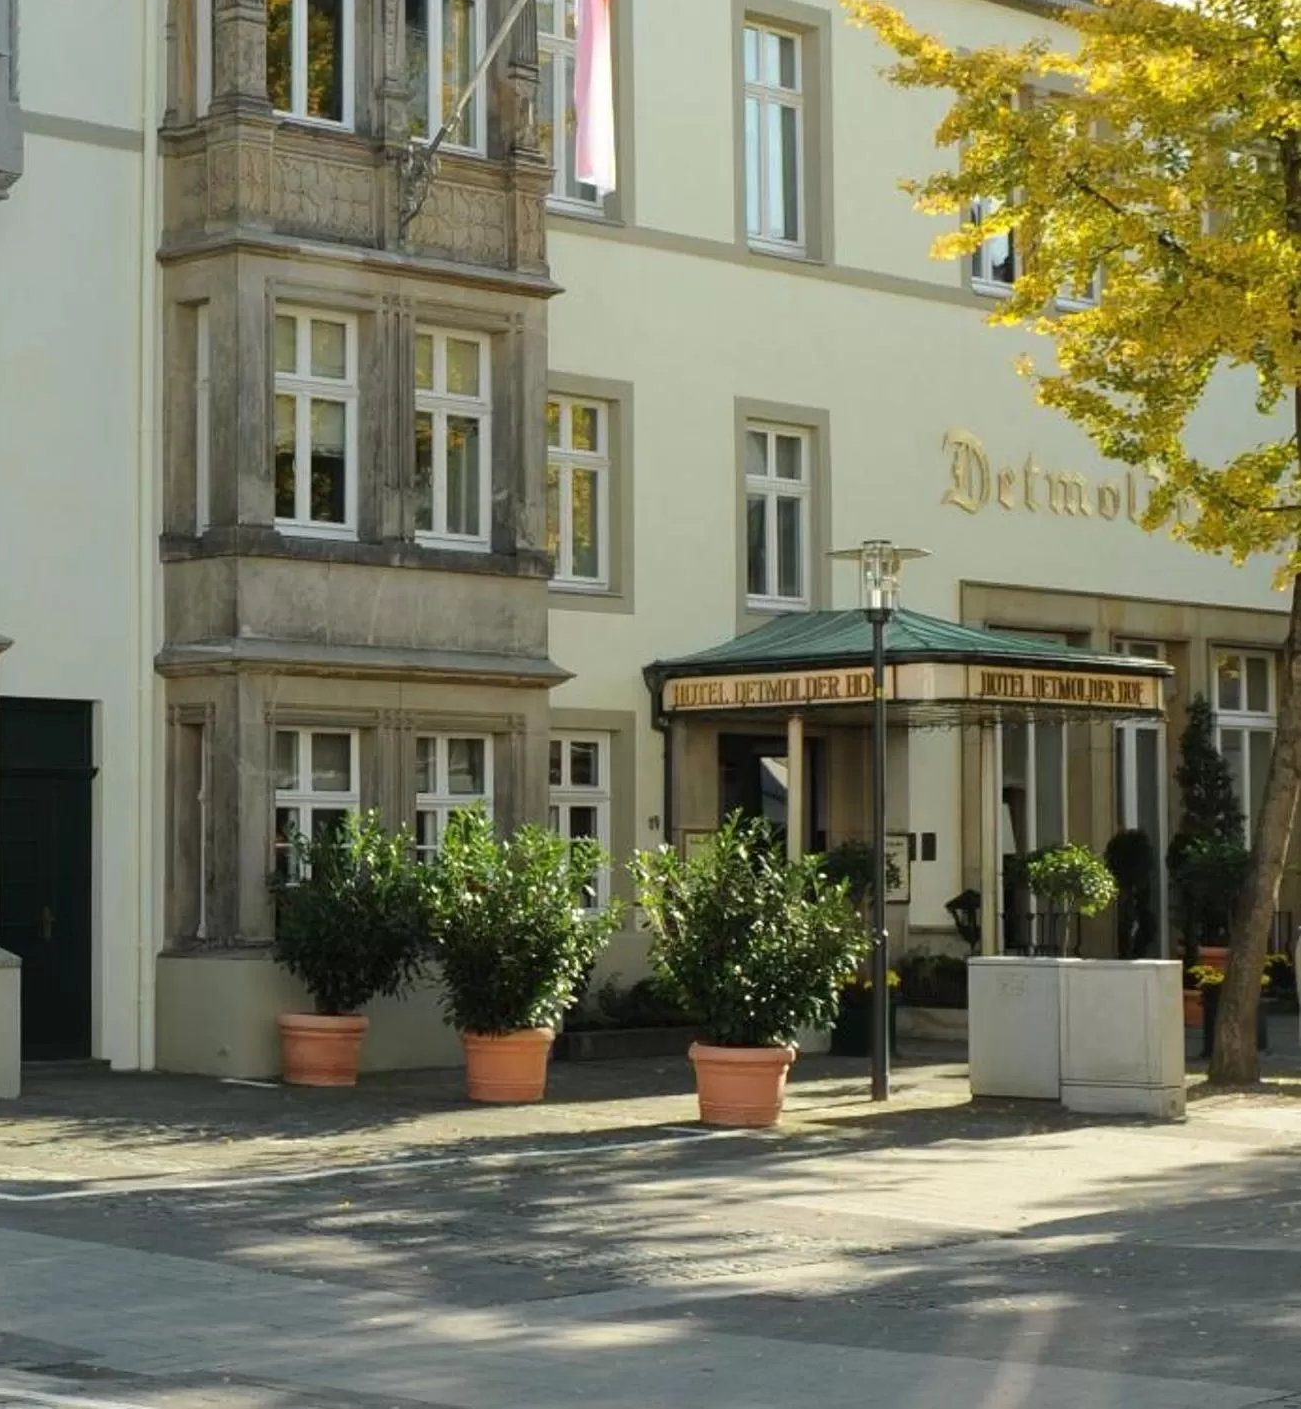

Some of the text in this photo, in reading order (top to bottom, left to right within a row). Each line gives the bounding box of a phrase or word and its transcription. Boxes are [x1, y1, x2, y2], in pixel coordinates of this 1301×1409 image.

[673, 671, 875, 708] HOTEL DETMOLDER HO
[980, 671, 1027, 698] HOTEL
[1032, 675, 1114, 703] DETMOLDER
